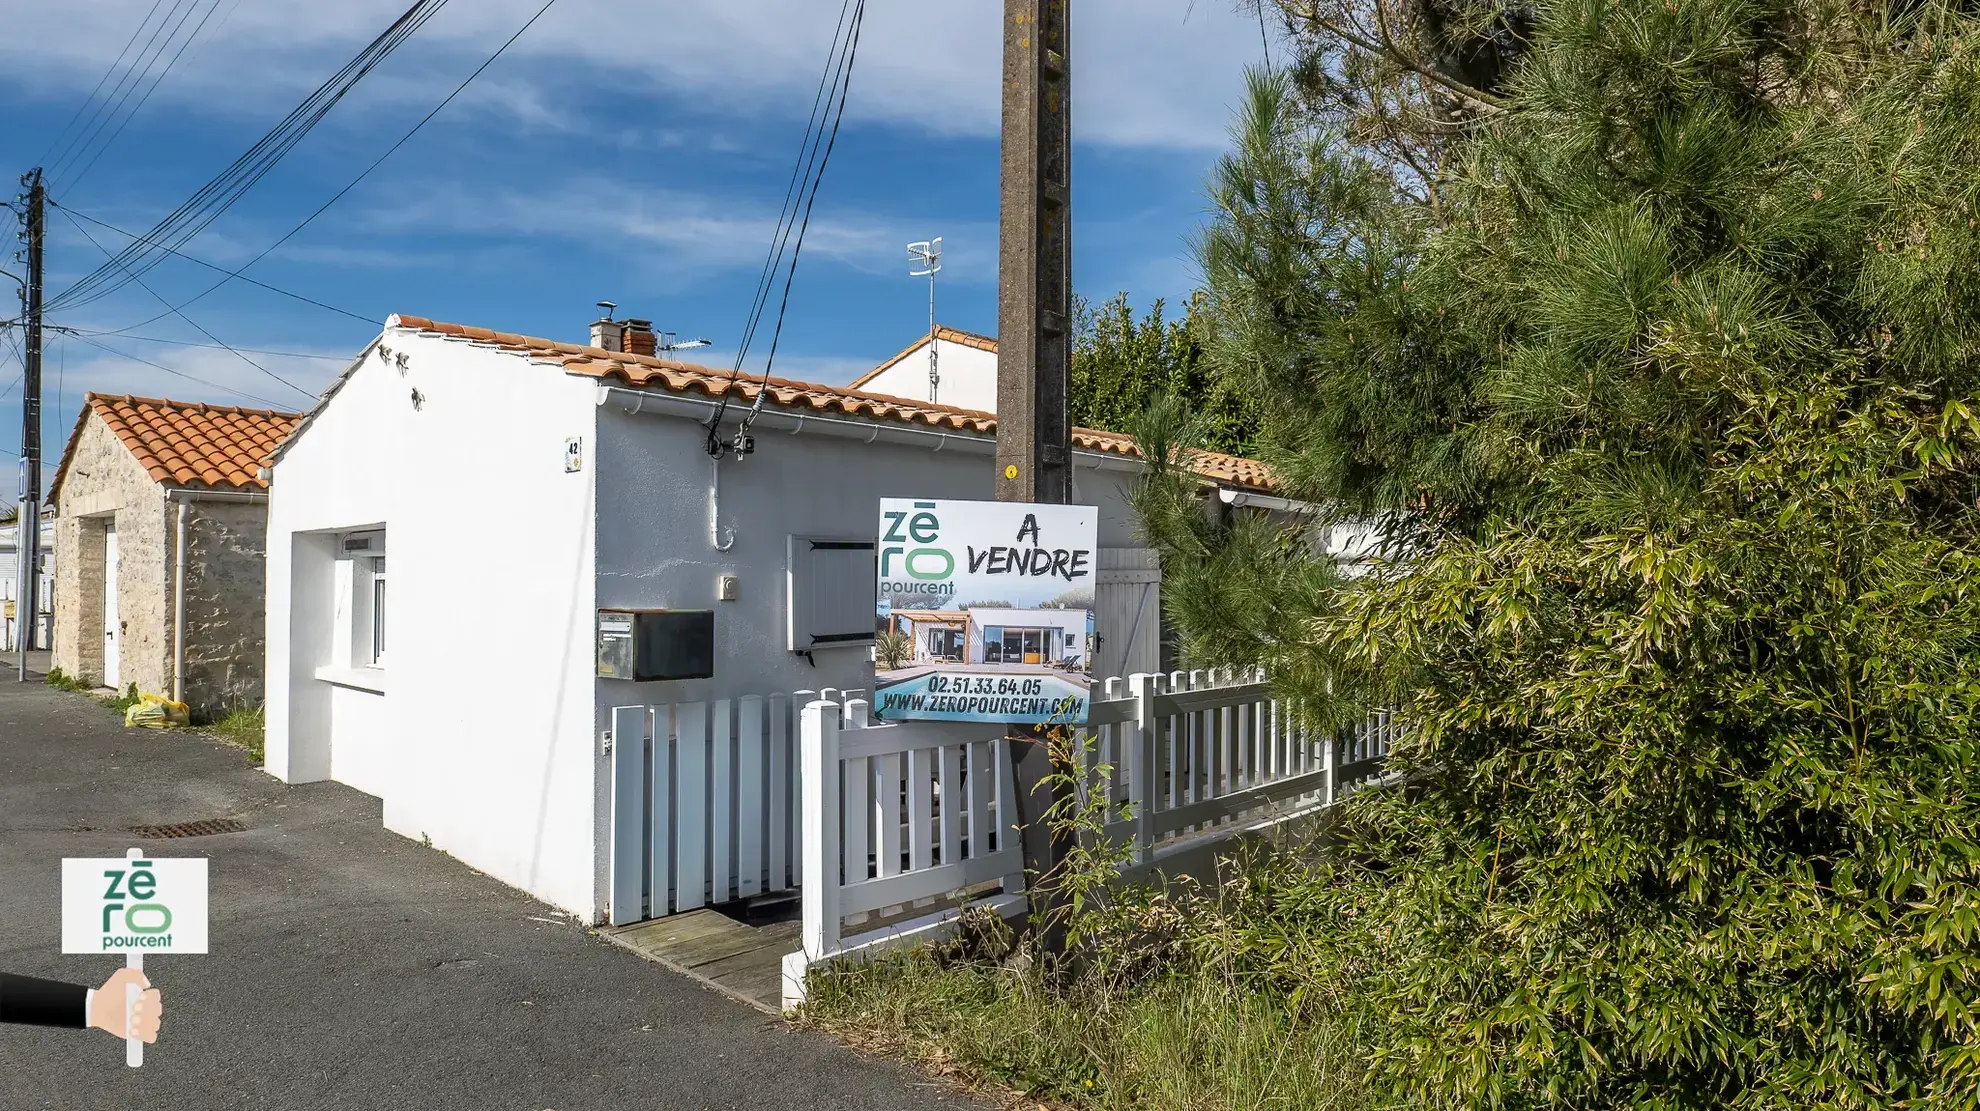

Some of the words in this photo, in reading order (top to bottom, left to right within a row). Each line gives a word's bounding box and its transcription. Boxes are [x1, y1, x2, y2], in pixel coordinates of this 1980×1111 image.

[569, 442, 578, 454] 42
[1017, 513, 1041, 547] A
[967, 545, 1090, 582] VENDRE
[880, 580, 955, 596] pourcent
[928, 676, 1042, 696] 02.51.33.64.05
